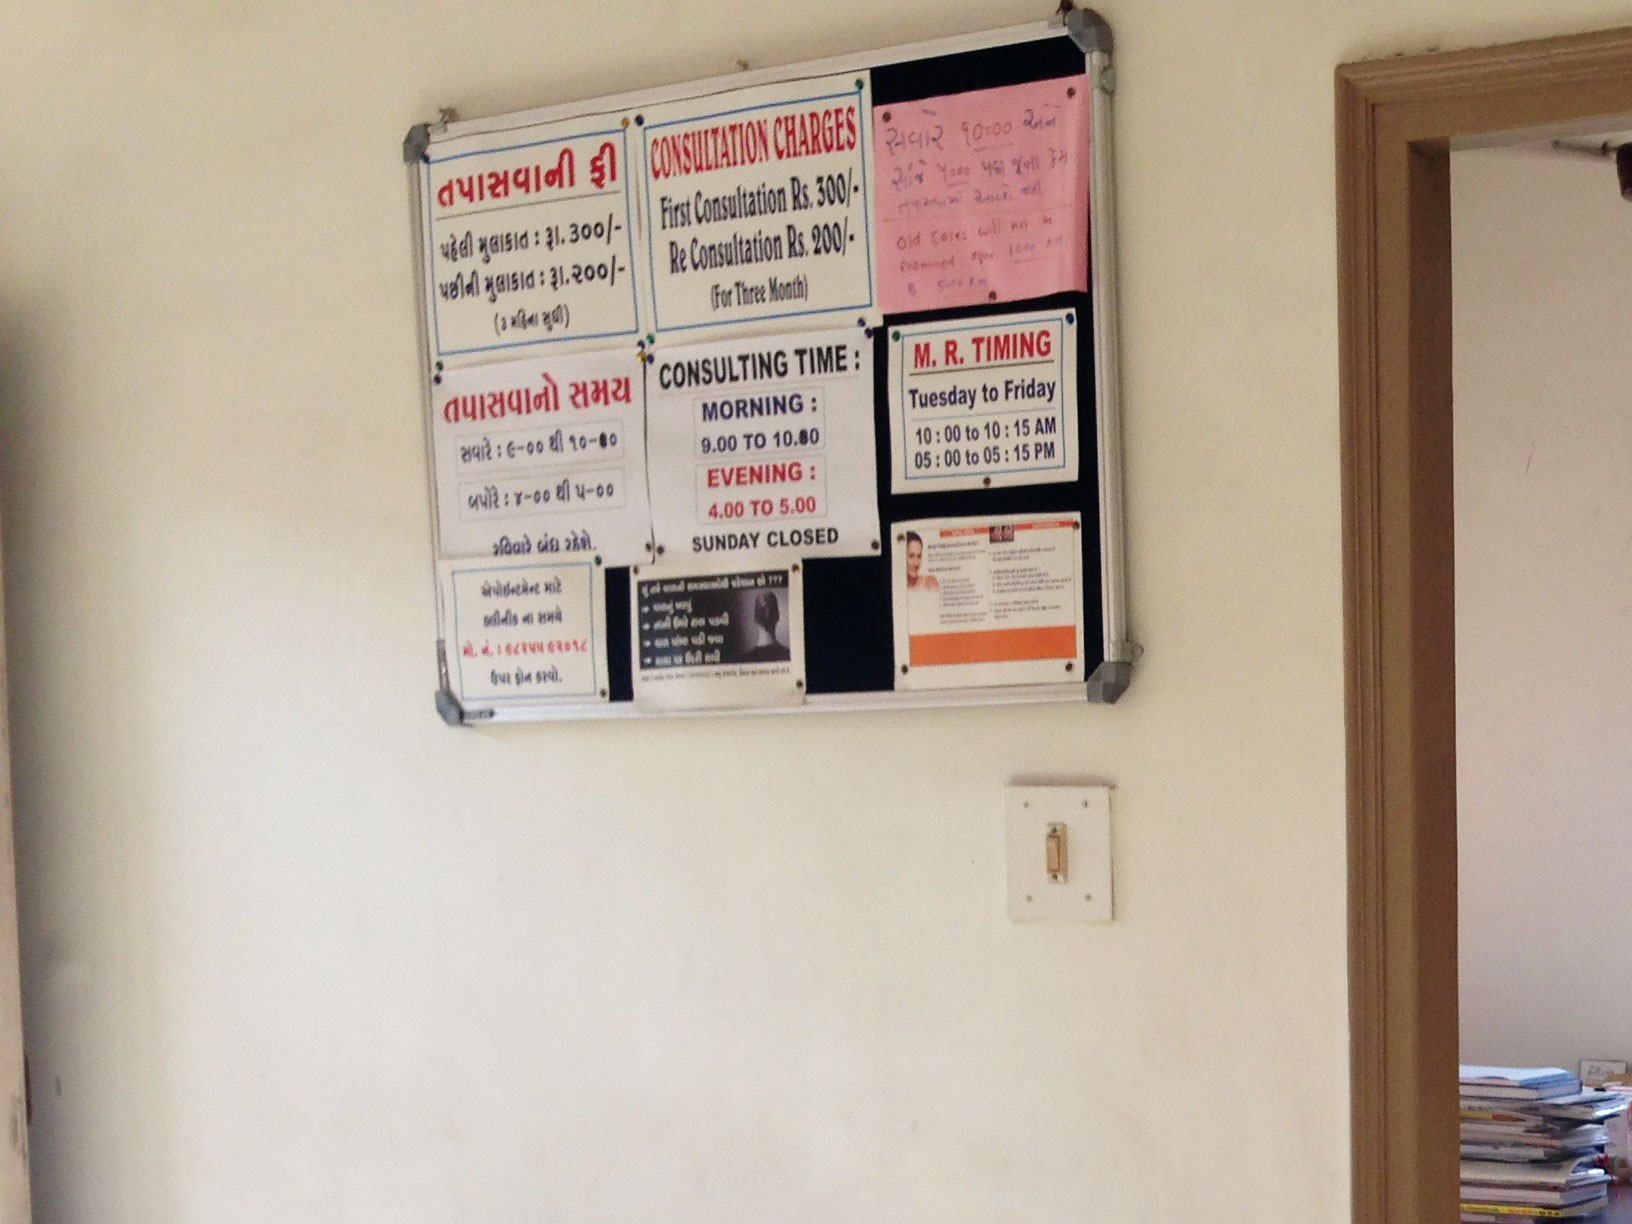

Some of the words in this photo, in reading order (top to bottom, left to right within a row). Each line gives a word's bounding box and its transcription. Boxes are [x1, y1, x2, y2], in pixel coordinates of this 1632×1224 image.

[650, 119, 770, 181] CONSULTATION
[773, 105, 857, 160] CHARGES
[437, 148, 575, 208] તપાસવાની
[590, 142, 616, 189] ફી
[660, 196, 692, 231] First
[694, 182, 788, 226] Consultation
[790, 176, 813, 211] Rs.
[816, 167, 859, 208] 300/-
[441, 231, 473, 263] પહેલી
[479, 231, 528, 264] મુલાકાત
[669, 241, 687, 274] Re
[691, 230, 783, 271] Consultation
[786, 224, 809, 259] Rs.
[812, 216, 855, 257] 200/-
[439, 270, 479, 301] પછીની
[485, 273, 535, 303] મુલાકાત
[711, 283, 733, 311] (For
[735, 281, 766, 306] Three
[768, 273, 809, 304] Month)
[914, 343, 937, 369] M.
[944, 339, 964, 366] R.
[972, 329, 1051, 363] TIMING
[659, 350, 788, 390] CONSULTING
[795, 345, 847, 376] TIME
[443, 372, 560, 424] તપાસવાનો
[569, 376, 632, 409] સમય
[702, 394, 803, 422] MORNING
[908, 385, 977, 410] Tuesday
[982, 383, 998, 402] to
[1005, 378, 1056, 402] Friday
[461, 437, 492, 464] સવારે
[549, 429, 564, 453] થી
[701, 435, 737, 454] 9.00
[743, 433, 766, 450] TO
[916, 427, 932, 445] 10
[944, 425, 961, 442] 00
[965, 425, 979, 441] to
[984, 421, 1000, 440] 10
[1013, 419, 1030, 437] 15
[1035, 416, 1057, 435] AM
[915, 452, 932, 469] 05
[944, 450, 961, 467] 00
[965, 449, 979, 466] to
[984, 446, 1000, 464] 05
[1013, 444, 1030, 462] 15
[1035, 441, 1055, 460] PM
[707, 461, 803, 488] EVENING
[467, 485, 500, 511] બપોરે
[556, 478, 570, 503] થી
[708, 501, 744, 520] 4.00
[750, 499, 773, 517] TO
[780, 496, 816, 515] 5.00
[693, 532, 760, 553] SUNDAY
[767, 527, 838, 547] CLOSED
